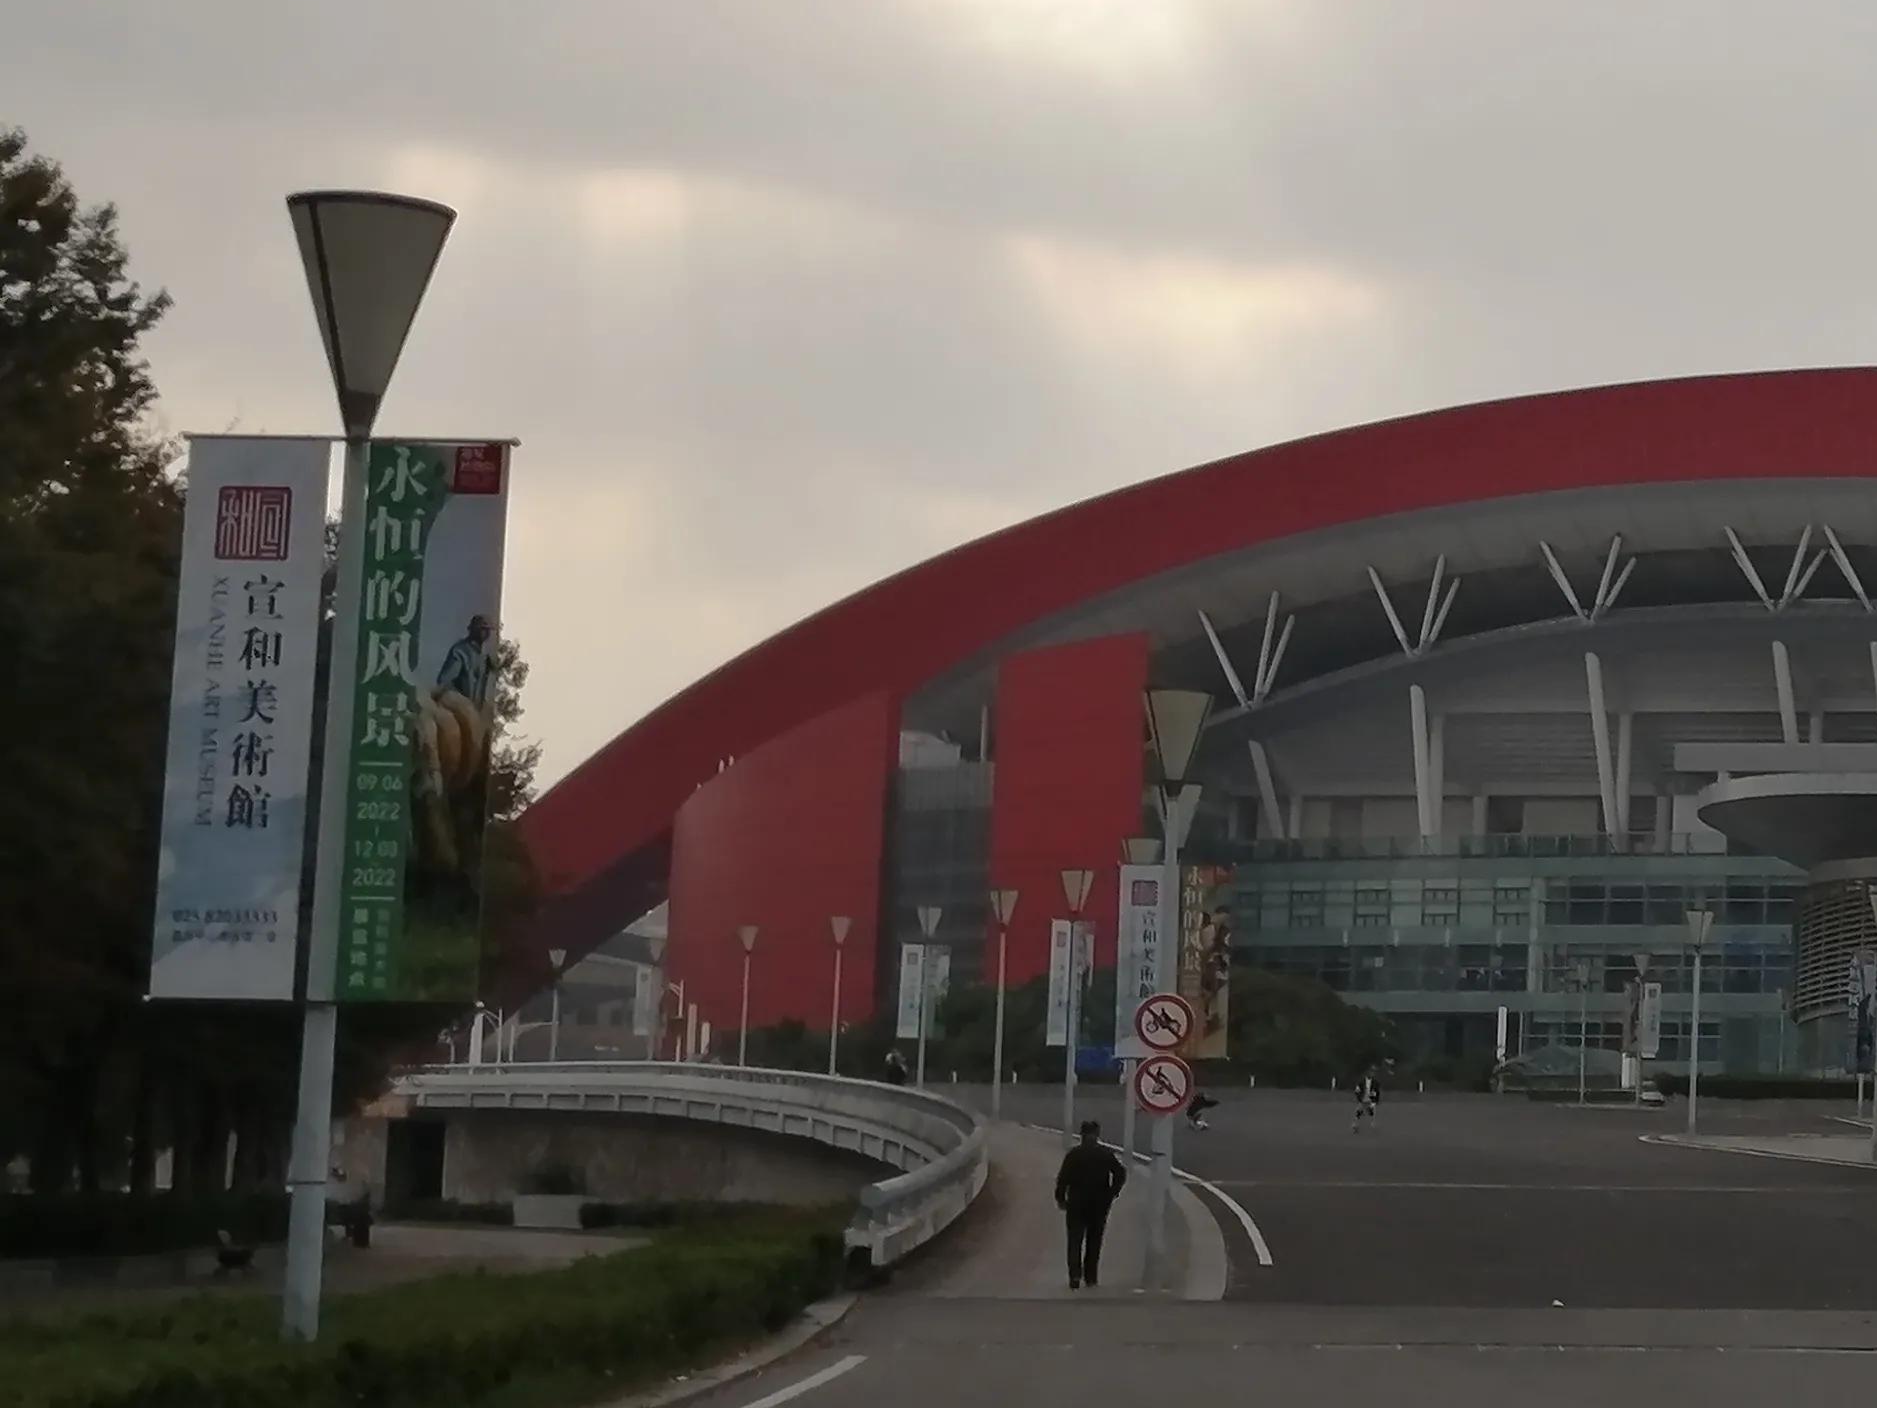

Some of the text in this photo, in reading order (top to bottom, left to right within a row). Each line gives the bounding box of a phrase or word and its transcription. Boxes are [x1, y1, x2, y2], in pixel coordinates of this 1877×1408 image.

[360, 446, 428, 748] 永恒的风景
[225, 574, 286, 830] 宣和美術館
[352, 868, 396, 887] 2022
[357, 801, 401, 821] 2022
